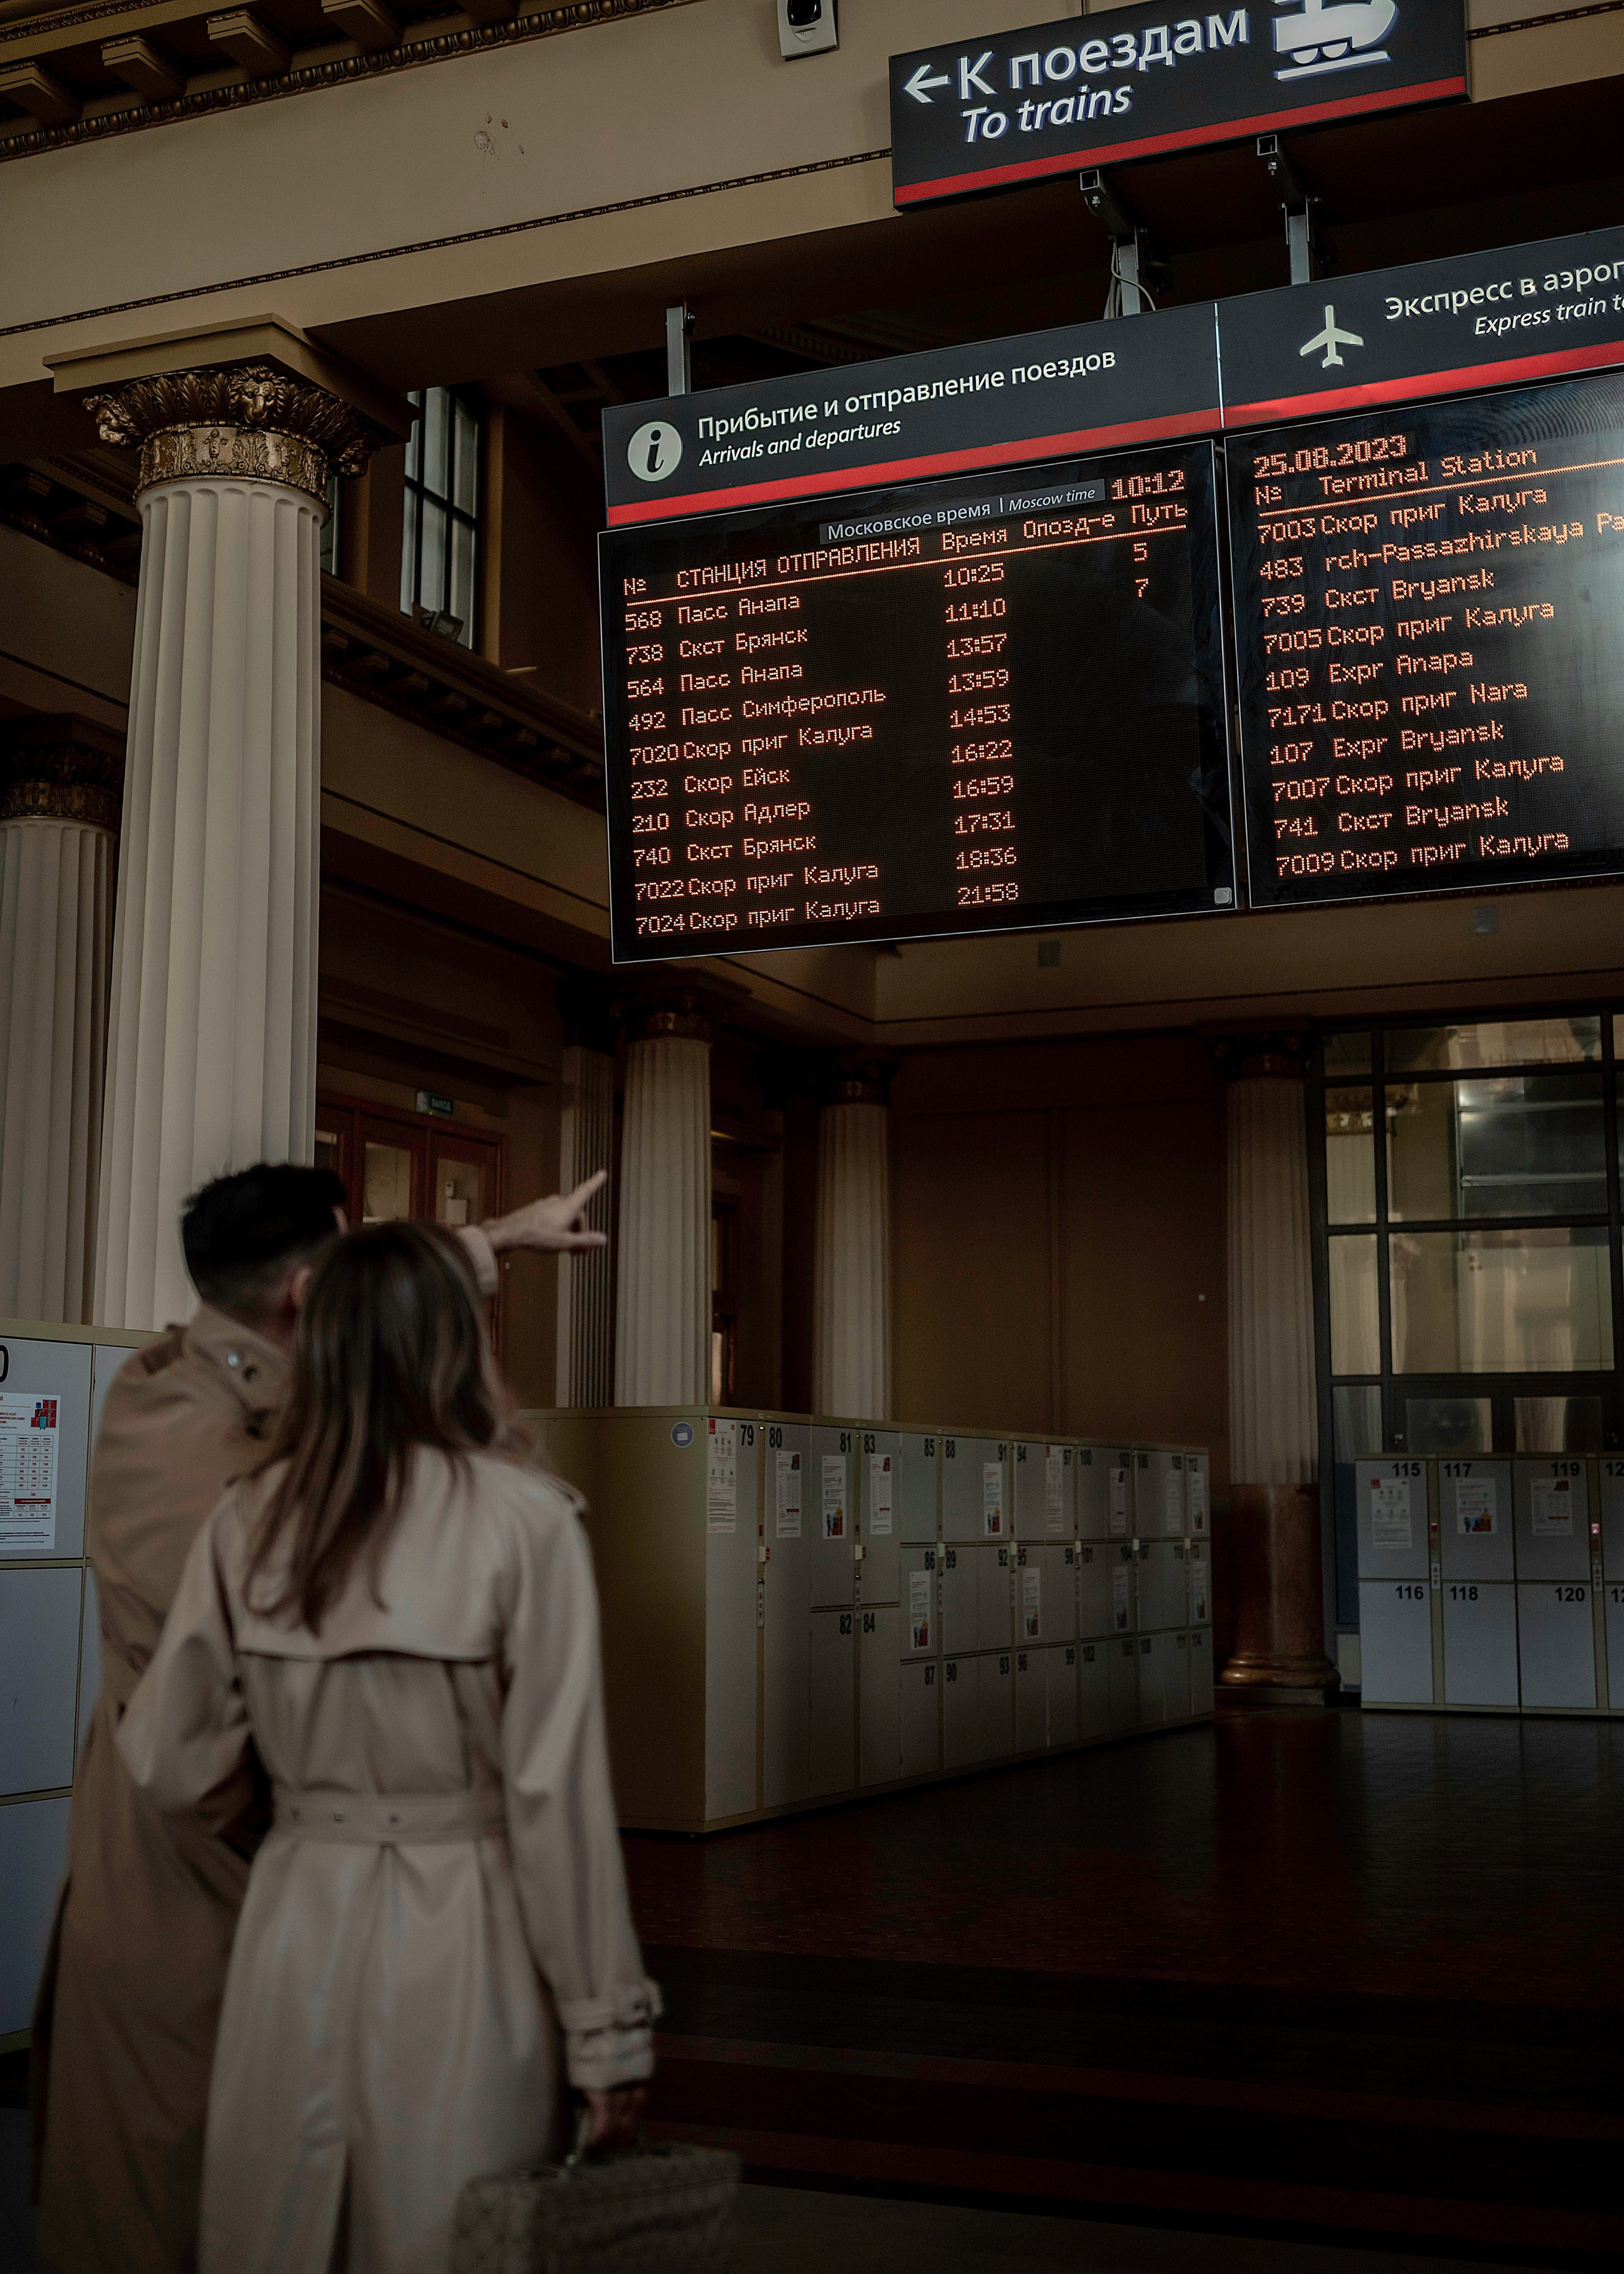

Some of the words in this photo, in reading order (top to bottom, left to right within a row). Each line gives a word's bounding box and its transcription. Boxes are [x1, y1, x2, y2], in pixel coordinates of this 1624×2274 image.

[960, 51, 997, 100] К
[1011, 8, 1248, 89] поездам
[962, 107, 1007, 143] To
[1018, 84, 1132, 132] trains
[1385, 281, 1514, 320] Экспресс
[1520, 278, 1538, 296] в
[1474, 308, 1550, 336] Express
[1556, 298, 1606, 321] train
[698, 404, 818, 442] Прибытие
[824, 399, 839, 417] и
[845, 371, 1005, 413] отправление
[1011, 352, 1116, 384] поездов
[698, 438, 763, 466] Arrivals
[767, 433, 802, 454] and
[805, 419, 901, 448] departures
[1254, 435, 1407, 479] 25.08.2023
[1111, 470, 1184, 500] 10:12
[1319, 461, 1429, 497] Terminal
[1441, 448, 1537, 478] Station
[1008, 494, 1061, 513] Moscow
[1065, 488, 1096, 503] time
[1257, 519, 1317, 544] 7003
[1321, 514, 1378, 536] Скор
[1389, 503, 1446, 529] приг
[1458, 489, 1547, 516] Калуга
[828, 512, 933, 540] Московское
[937, 504, 991, 527] время
[676, 558, 768, 591] СТАНЦИЯ
[777, 537, 921, 574] ОТПРАВЛЕНИЯ
[941, 528, 1009, 553] Время
[1023, 512, 1116, 540] Опозд-е
[1131, 503, 1188, 526] Путь
[1259, 556, 1304, 581] 483
[1325, 522, 1583, 572] rch-Passazhirskaya
[625, 610, 662, 631] 568
[678, 605, 728, 624] Пасс
[738, 595, 801, 616] Анапа
[943, 562, 1005, 588] 10:25
[1132, 542, 1148, 562] 5
[1261, 593, 1306, 618] 739
[1325, 588, 1380, 609] Скст
[1391, 568, 1494, 602] Bryansk
[625, 643, 664, 665] 738
[679, 640, 726, 658] Скст
[735, 628, 808, 654] Брянск
[945, 598, 1006, 623] 11:10
[1135, 577, 1149, 598] 7
[1263, 628, 1322, 655] 7005
[1326, 624, 1385, 647] Скор
[1396, 615, 1453, 640] приг
[1465, 602, 1555, 628] Калуга
[627, 677, 665, 699] 564
[680, 673, 731, 692] Пасс
[741, 664, 803, 685] Анапа
[946, 633, 1007, 659] 13:57
[1266, 667, 1309, 692] 109
[1328, 662, 1384, 685] Expr
[1396, 651, 1474, 676] Anapa
[629, 711, 666, 732] 492
[682, 707, 733, 726] Пасс
[742, 689, 887, 719] Симферополь
[948, 669, 1009, 693] 13:59
[1267, 702, 1327, 728] 7171
[1331, 699, 1389, 721] Скор
[1401, 691, 1457, 716] приг
[1469, 682, 1528, 704] Nara
[630, 744, 680, 766] 7020
[683, 741, 731, 760] Скор
[742, 734, 789, 756] приг
[798, 725, 873, 746] Калуга
[950, 704, 1011, 728] 14:53
[1270, 740, 1314, 765] 107
[1332, 737, 1388, 760] Expr
[1400, 719, 1503, 753] Bryansk
[631, 779, 669, 799] 232
[684, 775, 733, 794] Скор
[742, 767, 790, 788] Ейск
[951, 739, 1012, 765] 16:22
[1271, 777, 1330, 802] 7007
[1335, 774, 1393, 796] Скор
[1406, 766, 1462, 792] приг
[1475, 755, 1564, 781] Калуга
[632, 813, 670, 833] 210
[684, 809, 734, 828] Скор
[744, 801, 811, 825] Адлер
[952, 775, 1014, 799] 16:59
[1274, 815, 1318, 839] 741
[1337, 812, 1392, 833] Скст
[1405, 796, 1509, 829] Bryansk
[633, 846, 672, 867] 740
[686, 843, 733, 862] Скст
[742, 836, 816, 859] Брянск
[954, 810, 1016, 834] 17:31
[1276, 851, 1335, 876] 7009
[1340, 849, 1398, 871] Скор
[1410, 843, 1467, 867] приг
[1479, 832, 1569, 858] Калуга
[635, 879, 685, 900] 7022
[687, 877, 737, 897] Скор
[746, 873, 794, 894] приг
[804, 865, 879, 886] Калуга
[956, 846, 1016, 871] 18:36
[635, 913, 686, 935] 7024
[689, 912, 738, 931] Скор
[747, 907, 795, 928] приг
[804, 900, 880, 921] Калуга
[957, 882, 1019, 905] 21:58
[740, 1424, 754, 1447] 79
[769, 1426, 782, 1449] 80
[840, 1432, 851, 1454] 81
[864, 1433, 875, 1454] 83
[924, 1438, 935, 1457] 85
[945, 1440, 955, 1458] 88
[998, 1443, 1007, 1462] 91
[1017, 1445, 1026, 1462] 94
[1063, 1449, 1072, 1466] 97
[1392, 1462, 1421, 1477] 115
[1444, 1462, 1472, 1477] 117
[1550, 1462, 1580, 1477] 119
[924, 1551, 935, 1570] 86
[945, 1551, 956, 1568] 89
[998, 1548, 1007, 1567] 92
[1017, 1548, 1026, 1566] 95
[1065, 1547, 1073, 1565] 98
[1396, 1585, 1424, 1600] 116
[1450, 1586, 1478, 1601] 118
[1555, 1587, 1585, 1602] 120
[840, 1613, 851, 1634] 82
[863, 1612, 875, 1633] 84
[945, 1664, 957, 1682] 90
[999, 1657, 1009, 1675] 93
[1018, 1653, 1027, 1672] 96
[1065, 1648, 1074, 1666] 99
[924, 1666, 935, 1685] 87
